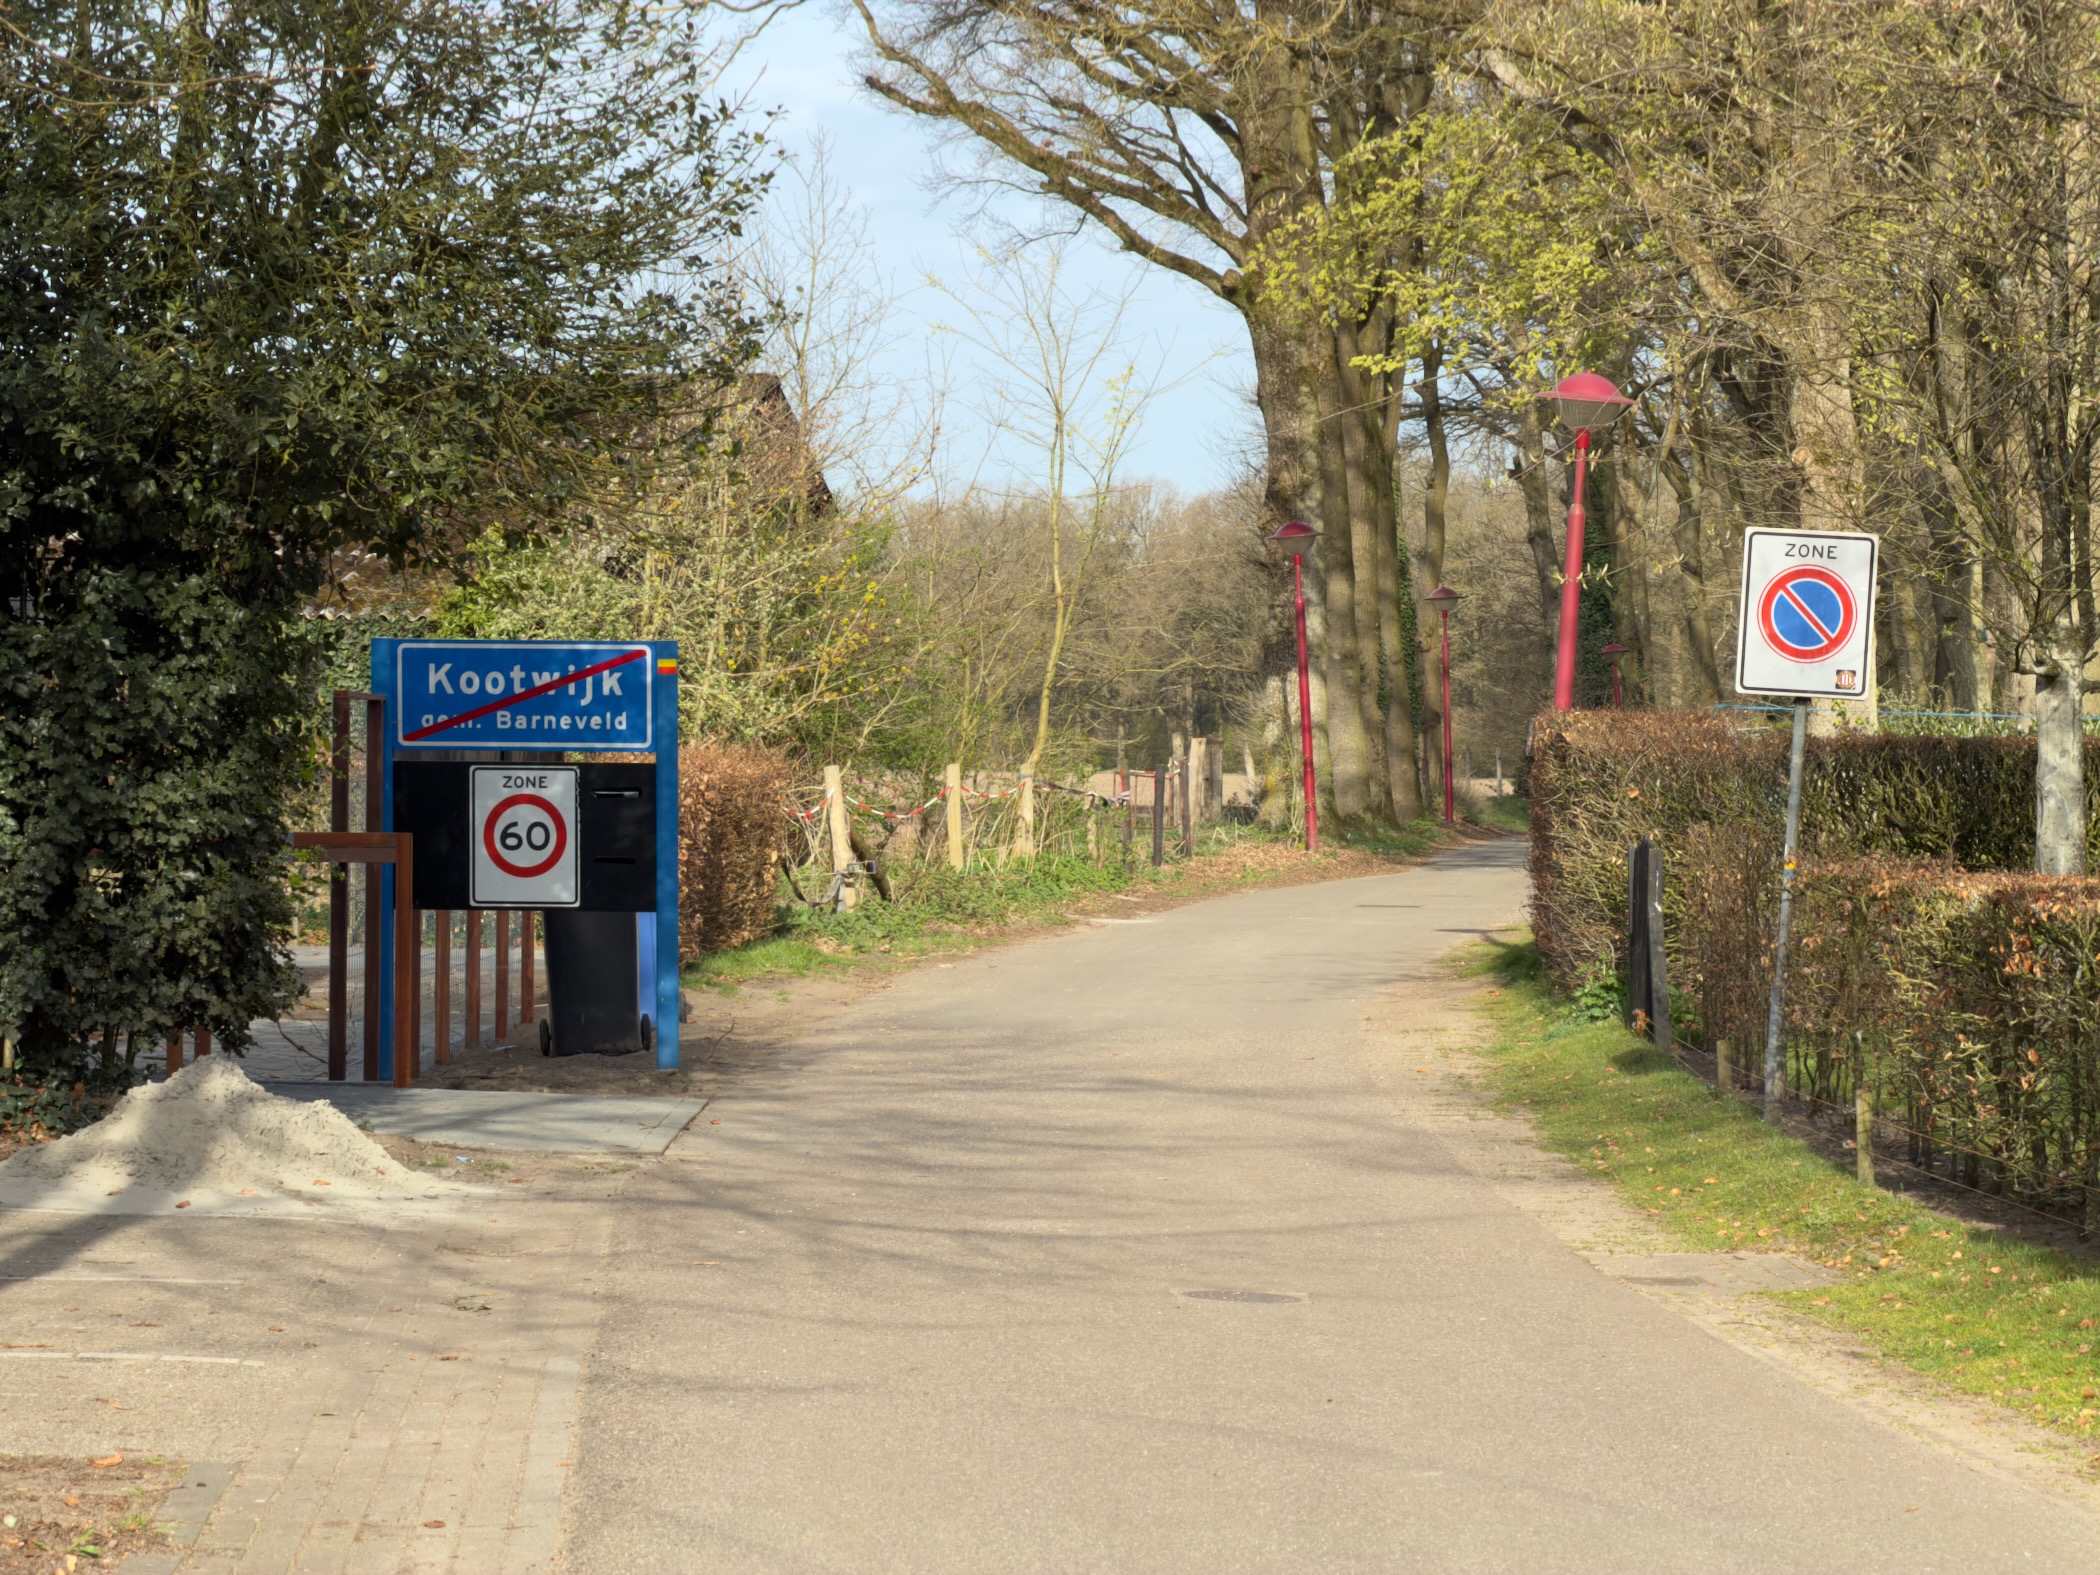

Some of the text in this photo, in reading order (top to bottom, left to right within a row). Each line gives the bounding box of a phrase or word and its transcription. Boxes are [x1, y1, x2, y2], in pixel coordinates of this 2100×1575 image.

[1784, 543, 1838, 560] ZONE
[428, 662, 623, 706] Kootwijk
[496, 710, 627, 731] Barneveld
[502, 775, 549, 789] ZONE
[499, 821, 551, 851] 60
